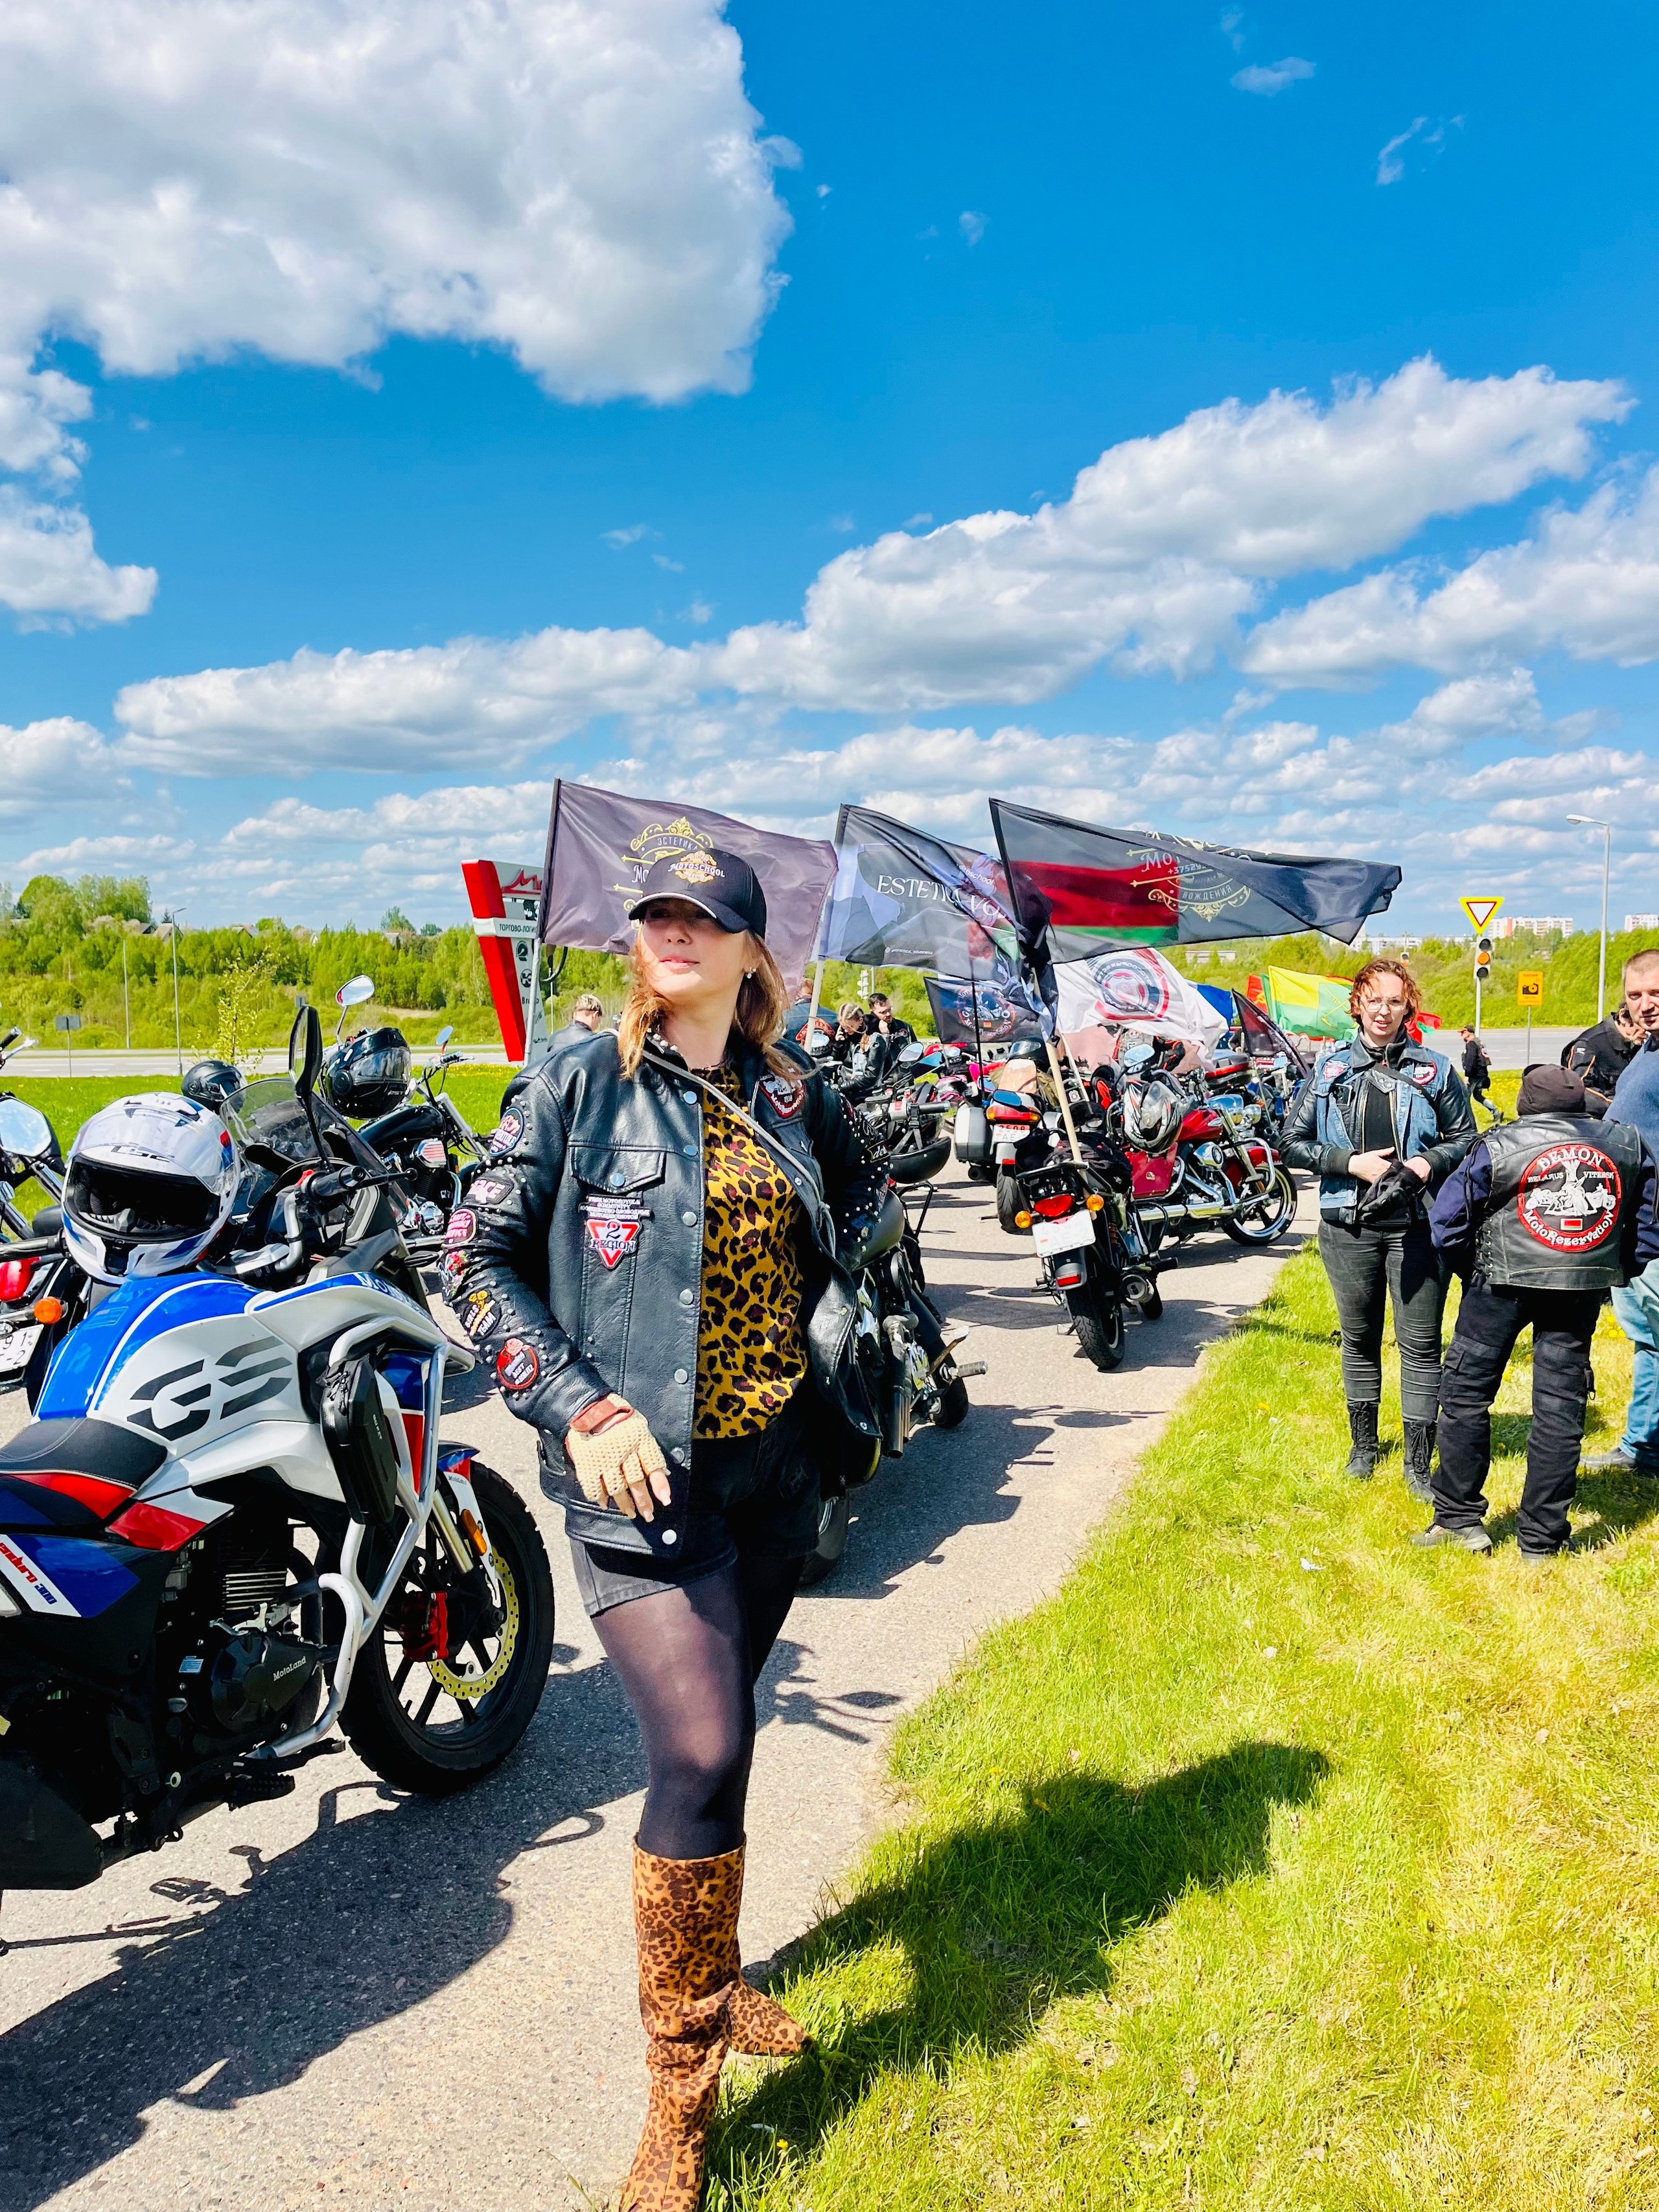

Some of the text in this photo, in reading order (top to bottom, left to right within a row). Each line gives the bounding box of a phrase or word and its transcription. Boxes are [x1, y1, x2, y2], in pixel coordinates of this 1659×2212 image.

[657, 836, 698, 851] ЭСТЕТИКА
[667, 862, 725, 878] MOTOSCHOOL
[1182, 885, 1233, 902] ВОЖДЕНИЯ
[998, 1124, 1027, 1134] 2508
[1537, 1147, 1605, 1172] DEMON
[1527, 1172, 1564, 1183] BELARUS
[1583, 1170, 1615, 1180] VITEBSK
[606, 1222, 621, 1239] 2
[592, 1239, 636, 1252] REGION
[478, 1310, 496, 1336] TEAM
[273, 1655, 307, 1682] MotoLand
